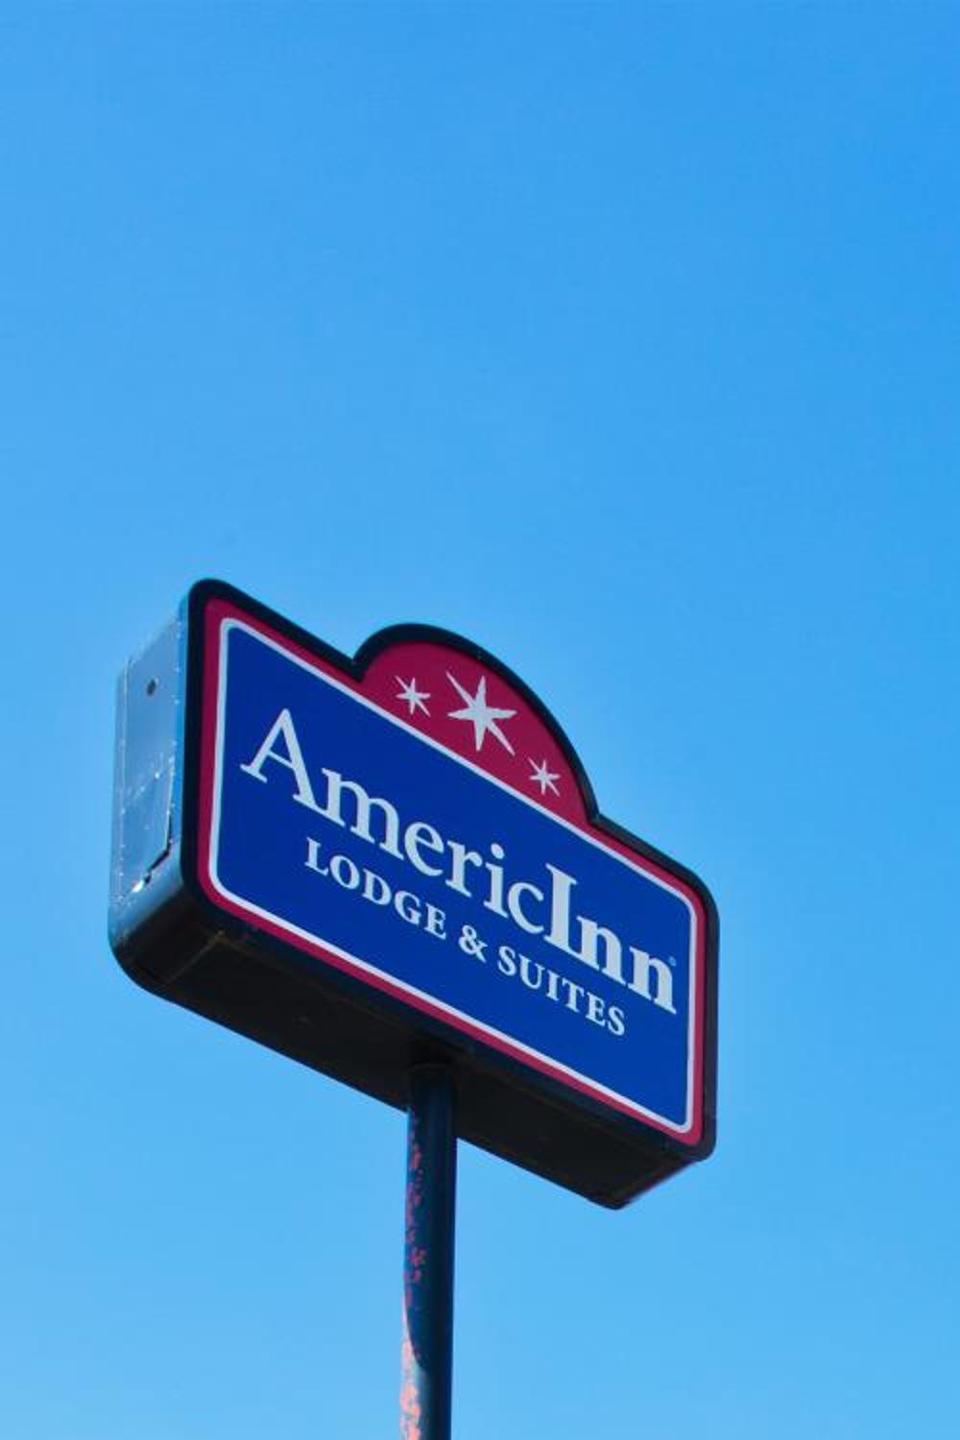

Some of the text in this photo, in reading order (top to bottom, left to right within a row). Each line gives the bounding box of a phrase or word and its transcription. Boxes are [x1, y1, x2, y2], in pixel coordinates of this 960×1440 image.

[240, 708, 677, 1015] AmericInn
[305, 836, 626, 1037] LODGE & SUITES
